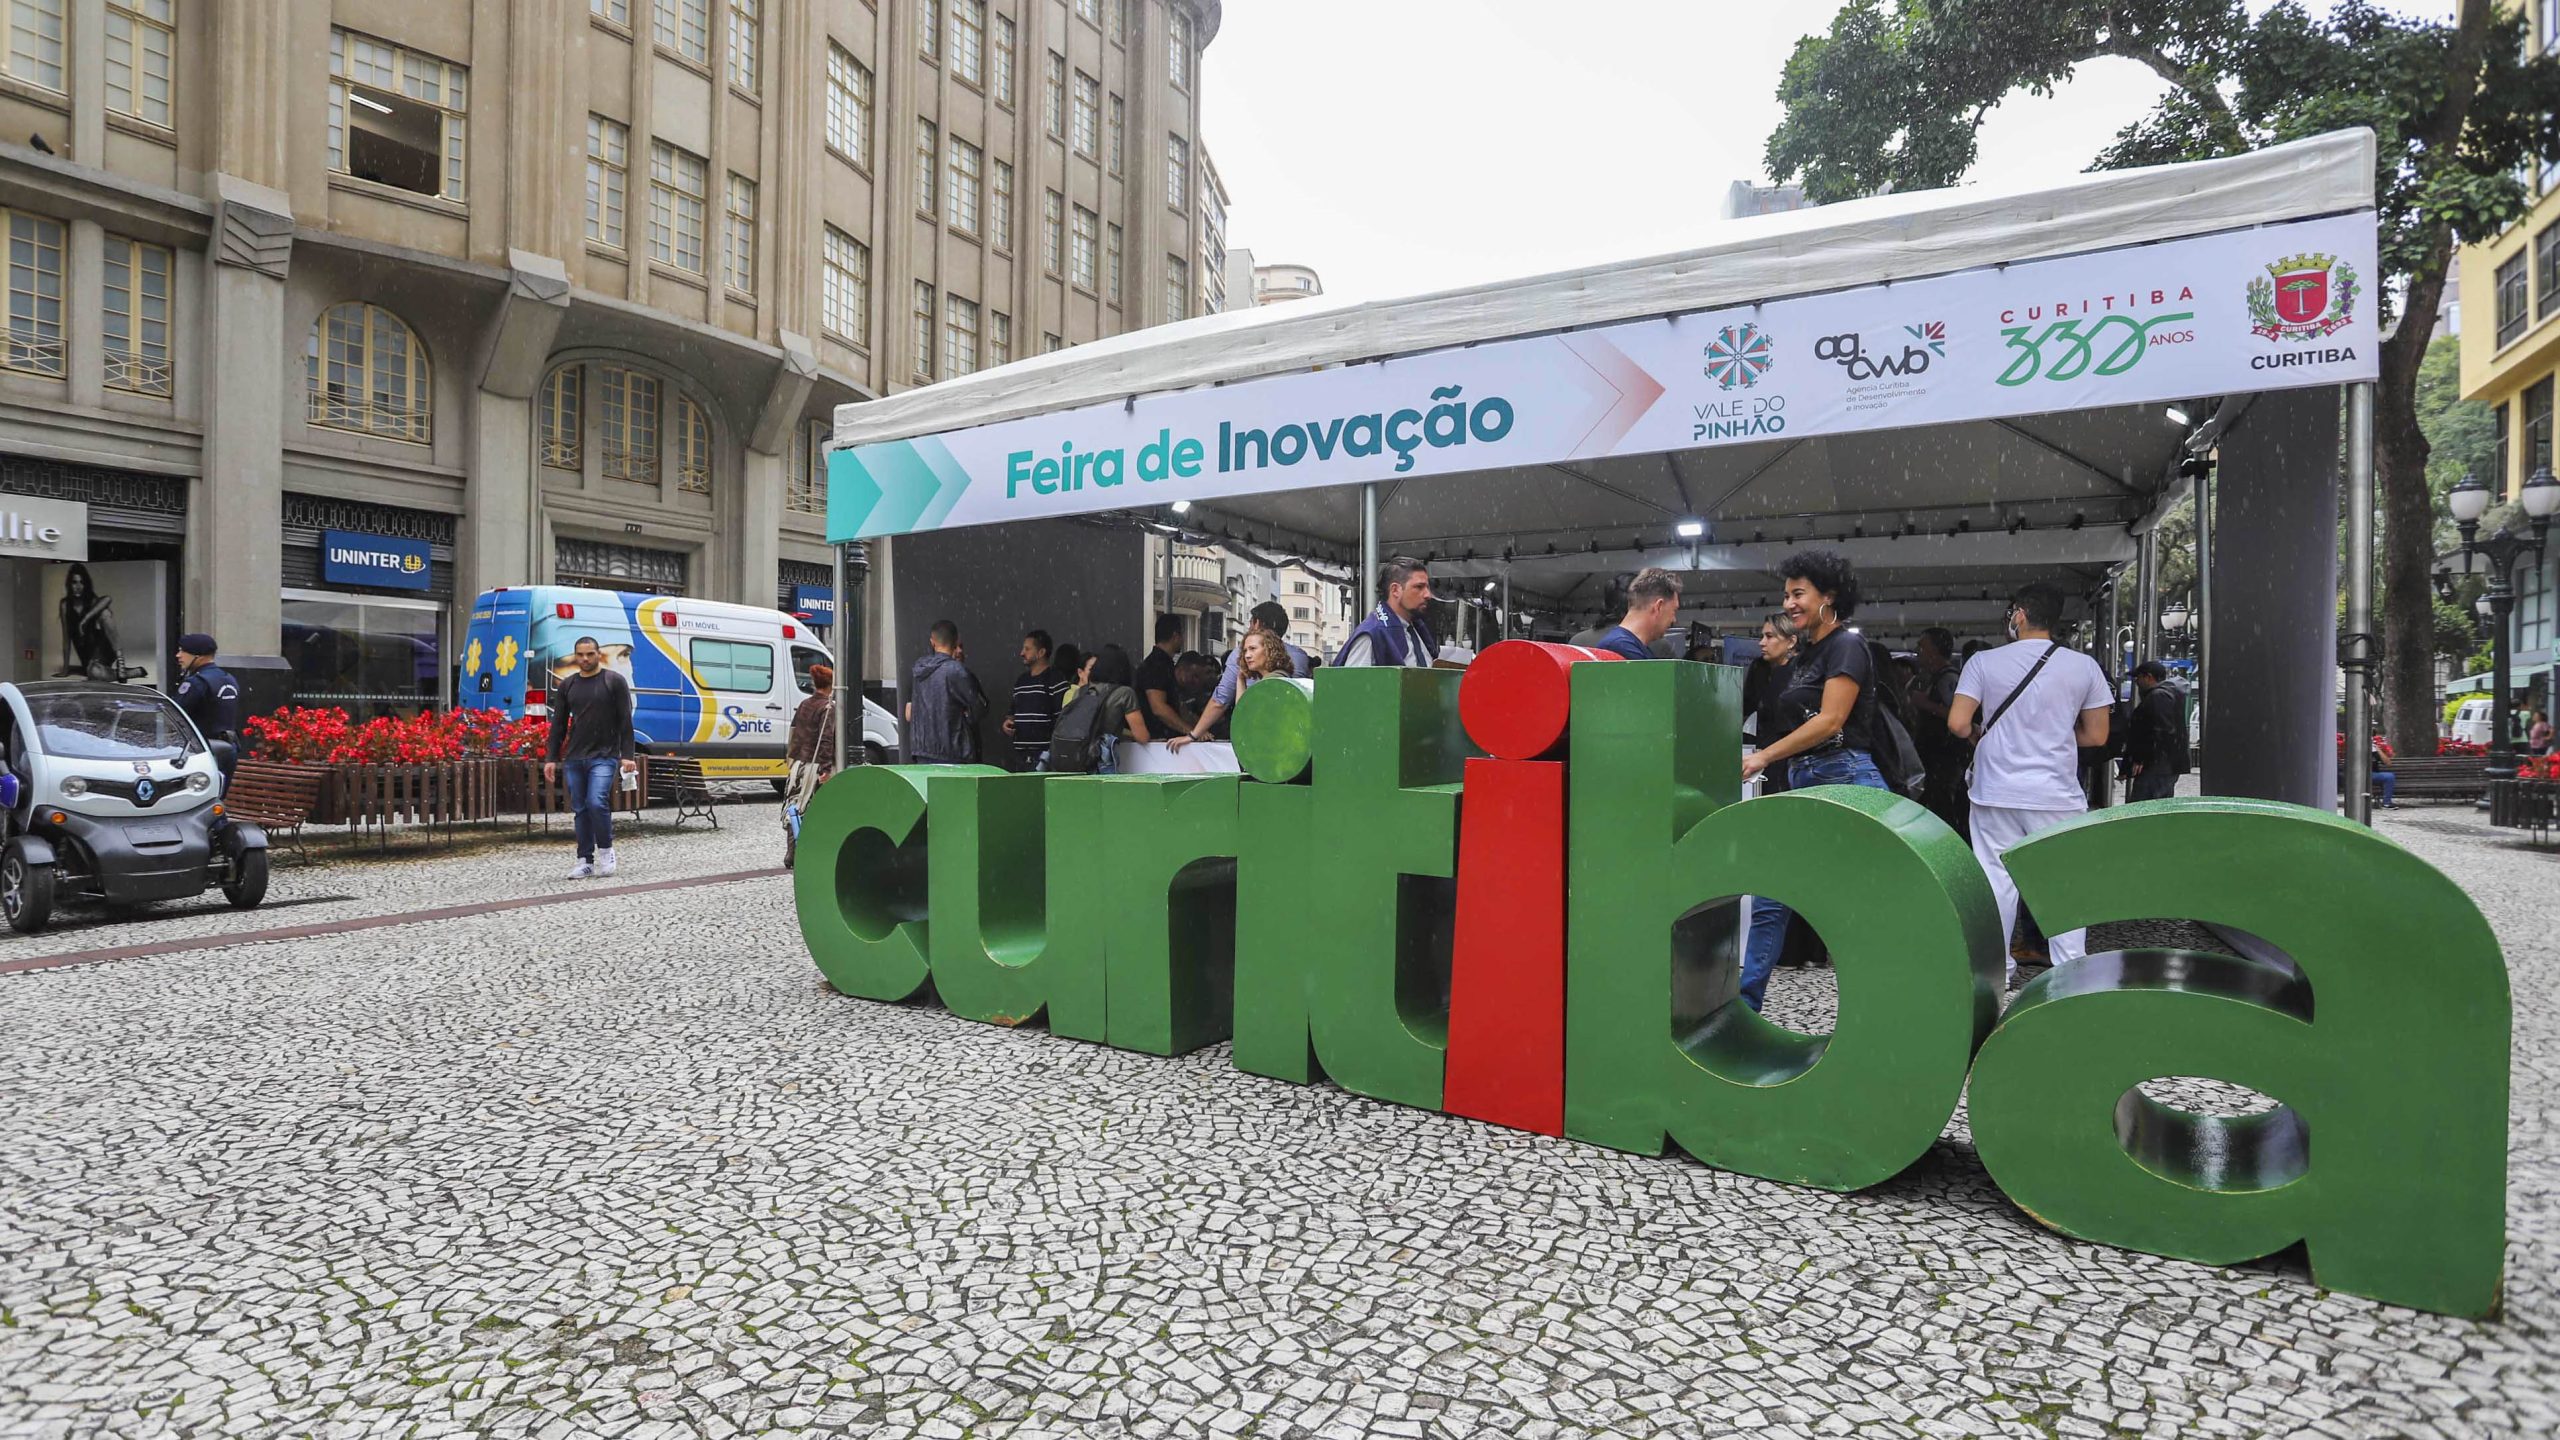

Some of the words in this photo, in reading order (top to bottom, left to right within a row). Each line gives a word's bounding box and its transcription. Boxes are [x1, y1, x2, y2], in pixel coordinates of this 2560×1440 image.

[2001, 286, 2194, 323] CURITIBA
[2280, 322, 2322, 333] CURITIBA
[1995, 311, 2194, 387] 330
[2149, 330, 2194, 347] ANOS
[2250, 347, 2357, 370] CURITIBA
[1846, 385, 1878, 396] Agência
[1879, 381, 1910, 391] Curitiba
[1846, 394, 1857, 403] de
[1858, 388, 1926, 402] Desenvolvimento
[1694, 400, 1743, 419] VALE
[1754, 395, 1785, 414] DO
[1846, 404, 1852, 412] e
[1693, 414, 1785, 441] PINHÃO
[1006, 440, 1125, 499] Feira
[1137, 428, 1205, 482] de
[1218, 384, 1515, 473] Inovação
[330, 548, 400, 569] UNINTER
[794, 640, 2513, 1317] curitiba
